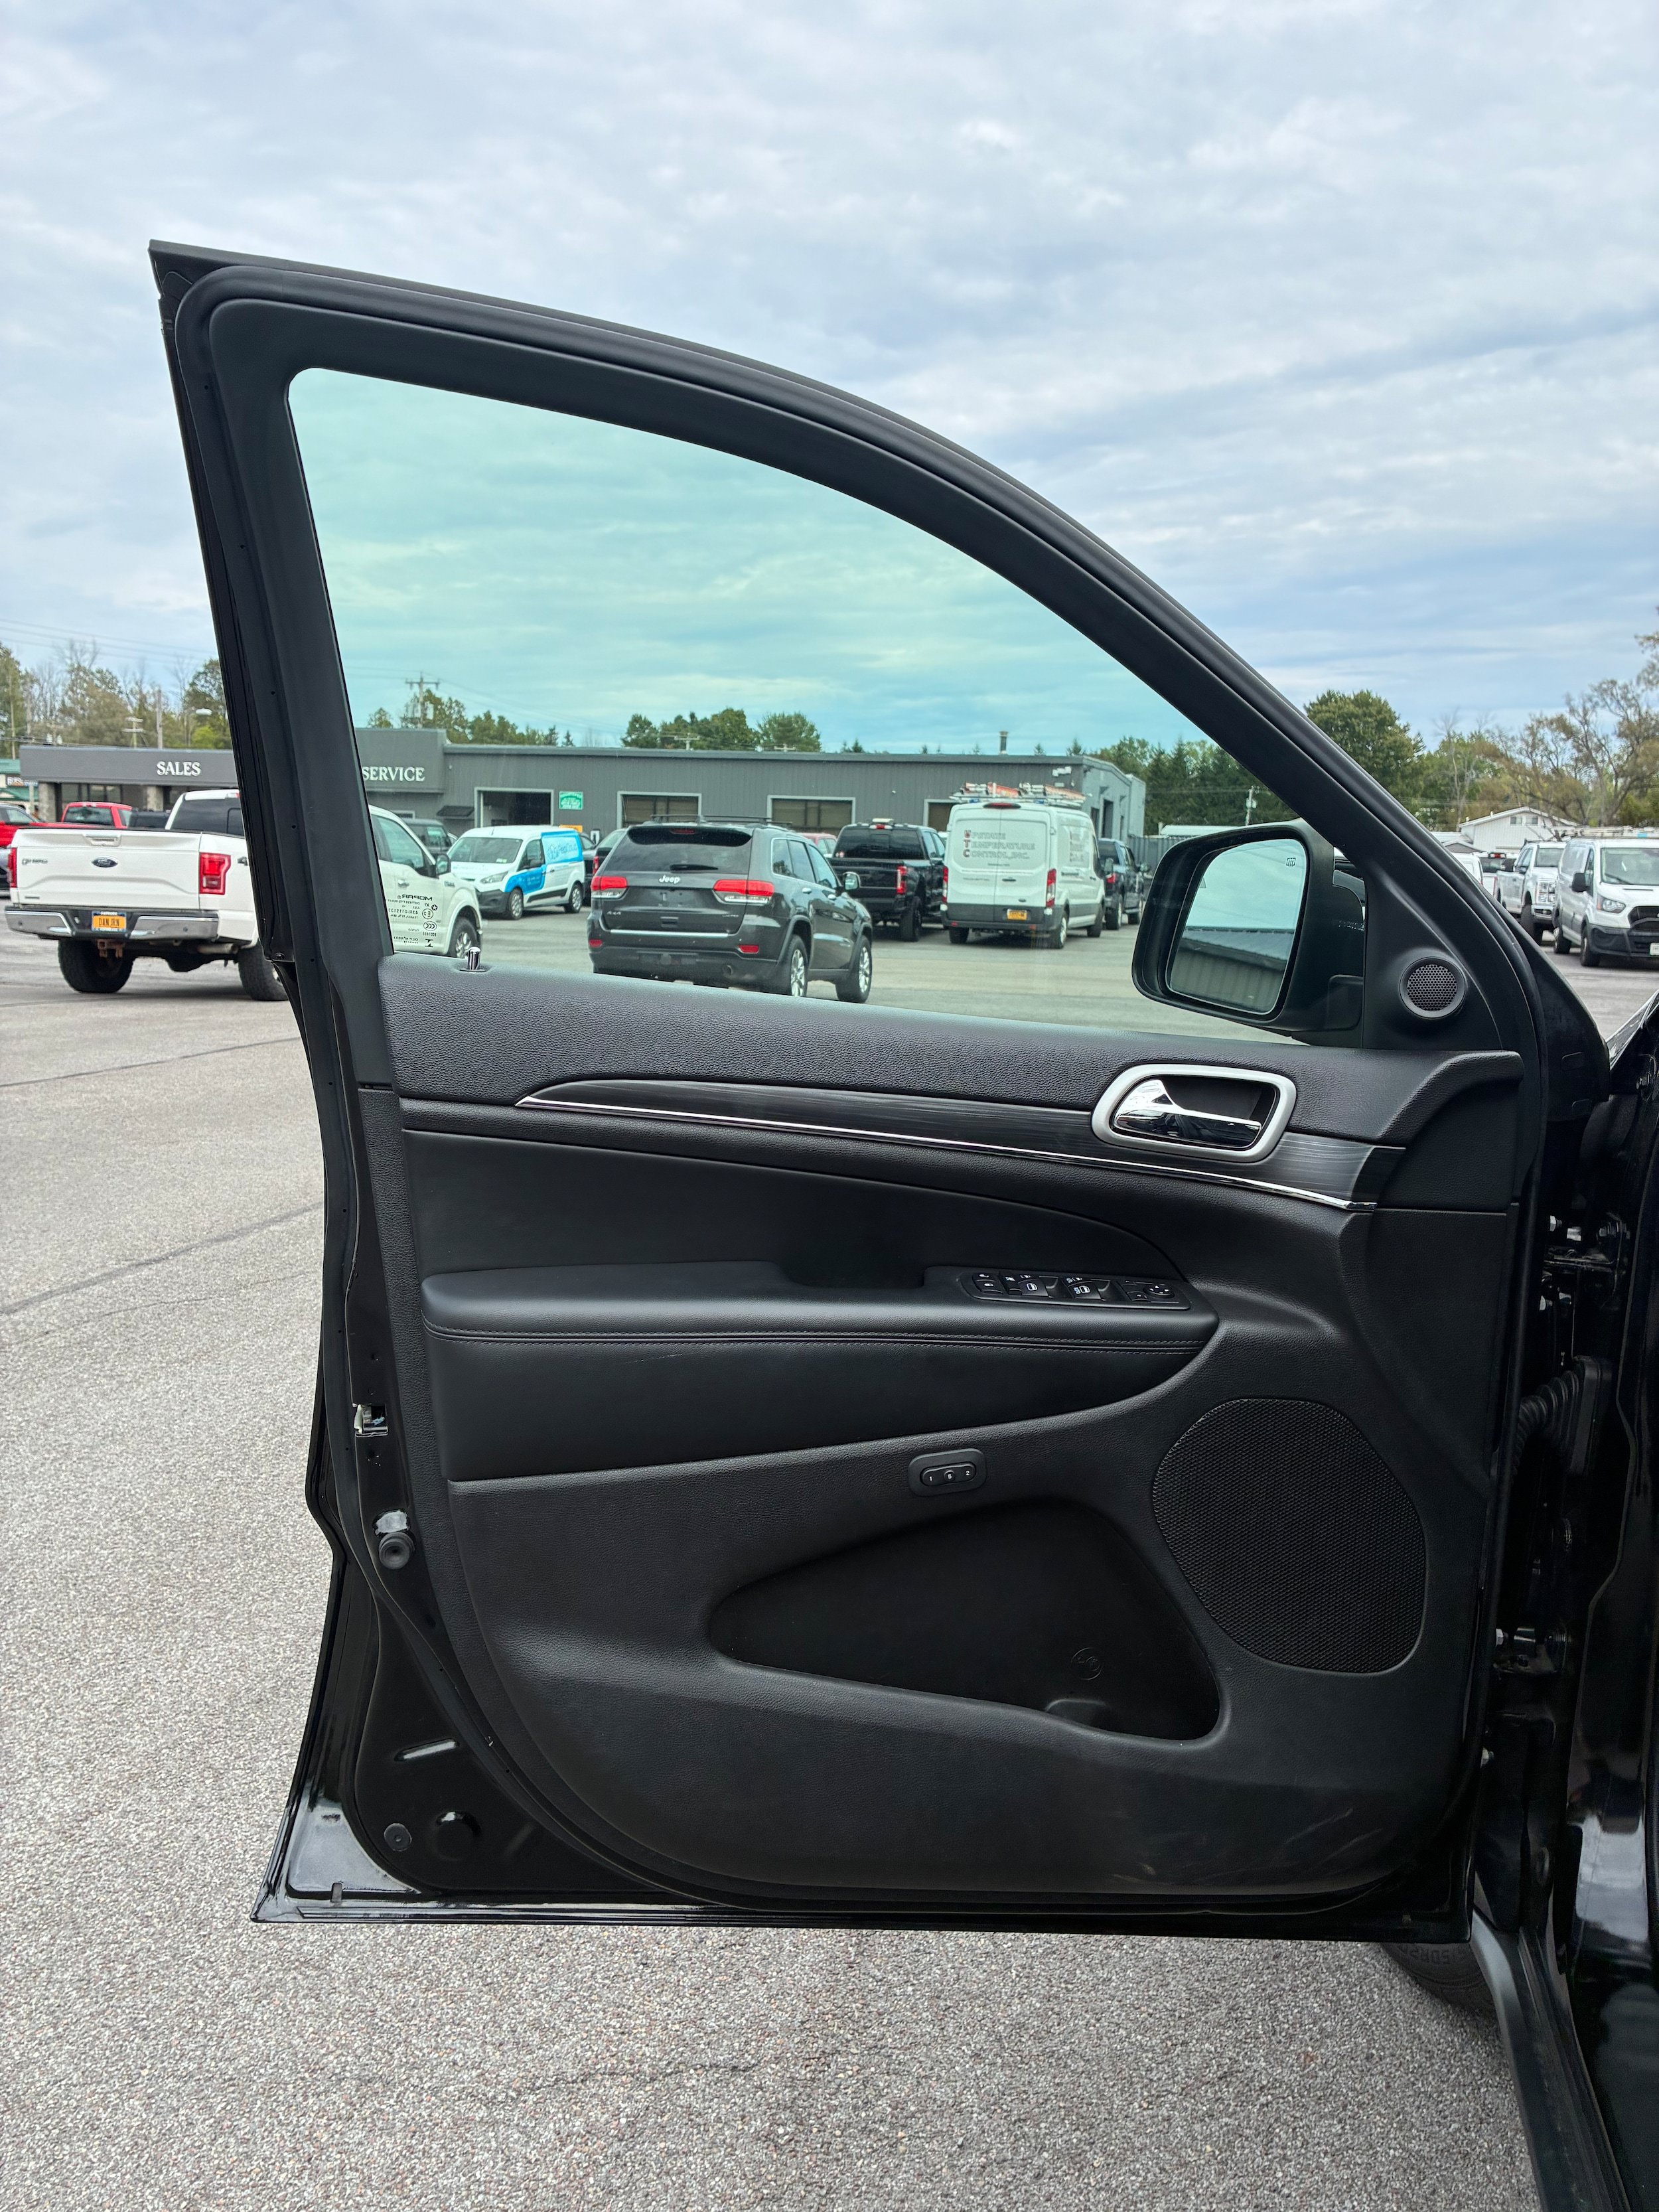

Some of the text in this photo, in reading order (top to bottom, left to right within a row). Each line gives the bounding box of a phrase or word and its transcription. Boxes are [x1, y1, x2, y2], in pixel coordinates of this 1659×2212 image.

[157, 761, 202, 776] SALES
[362, 766, 425, 782] SERVICE
[658, 874, 680, 885] Jeep
